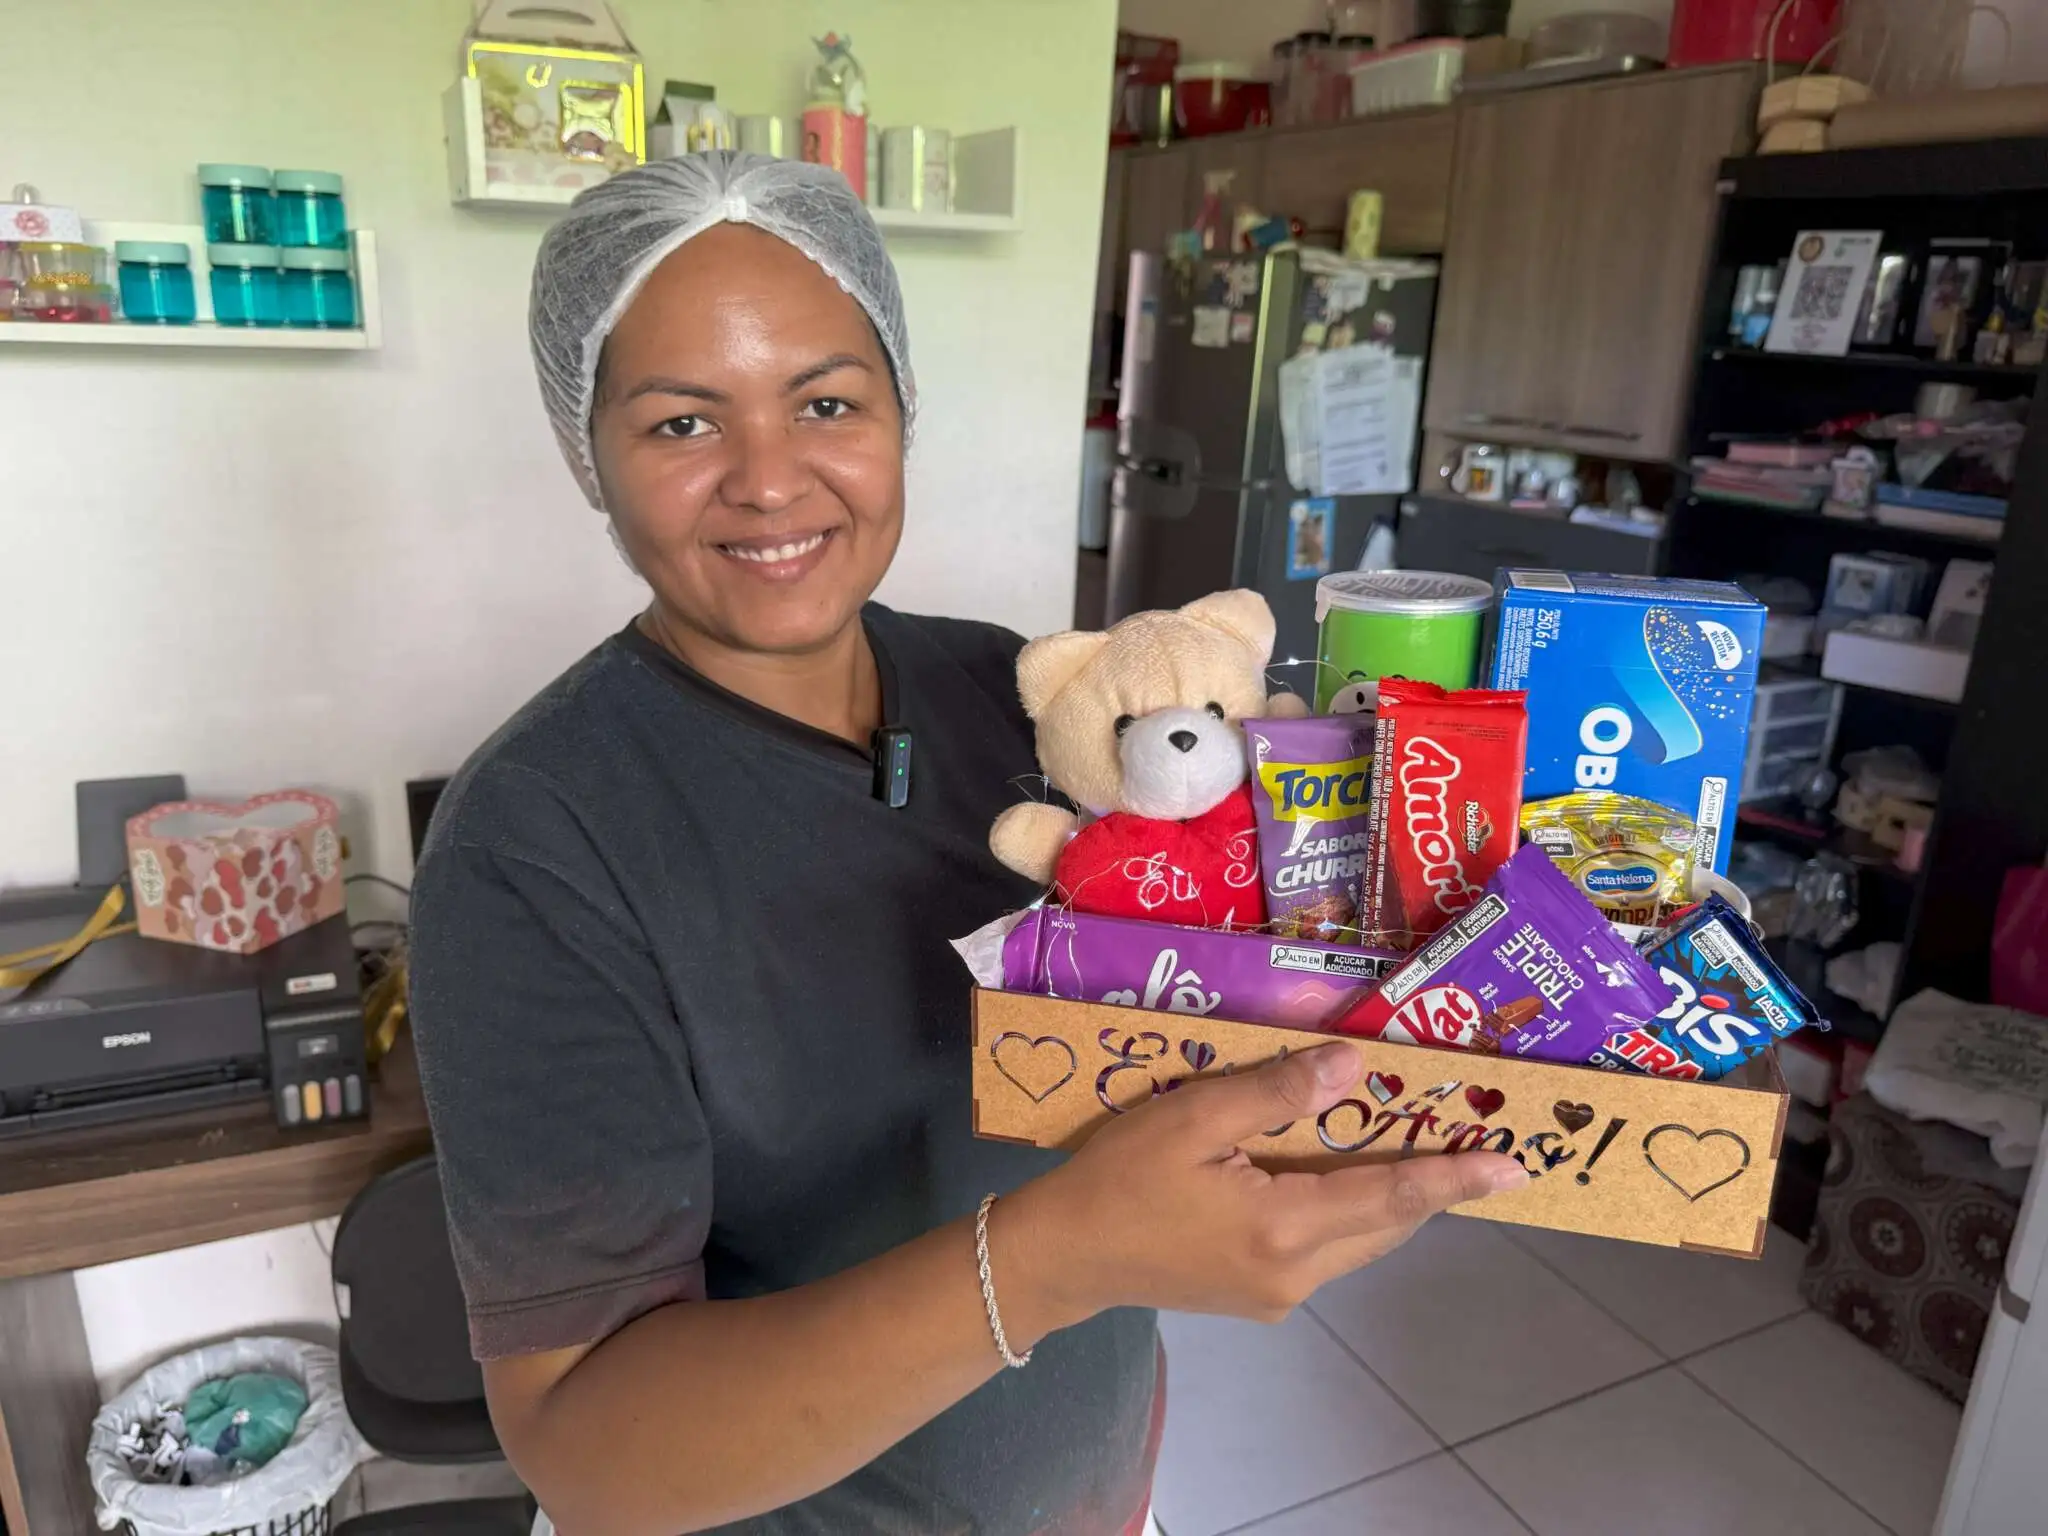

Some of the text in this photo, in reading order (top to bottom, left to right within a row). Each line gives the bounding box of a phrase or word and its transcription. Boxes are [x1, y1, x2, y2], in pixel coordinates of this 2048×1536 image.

[1531, 608, 1554, 648] 250,6 g
[1721, 630, 1736, 652] NOVA
[1574, 706, 1632, 792] OB
[1369, 718, 1387, 832] WAFER COM RECHEIO SABOR CHOCOLATE
[1465, 800, 1481, 856] Richester
[1588, 872, 1654, 885] Santa Helena
[1051, 920, 1076, 930] NOVO
[1461, 900, 1495, 928] GORDURA
[1467, 906, 1501, 936] SATURADA
[1288, 954, 1320, 965] ALTO EM
[1428, 937, 1466, 972] ADICIONADO
[1492, 948, 1517, 974] SABOR
[1519, 922, 1585, 990] CHOCOLATE
[1325, 964, 1373, 977] ADICIONADO
[1397, 963, 1424, 991] ALTO EM
[1500, 932, 1574, 1012] TRIPLE
[1756, 994, 1789, 1029] LACTA
[103, 1031, 151, 1048] EPSON
